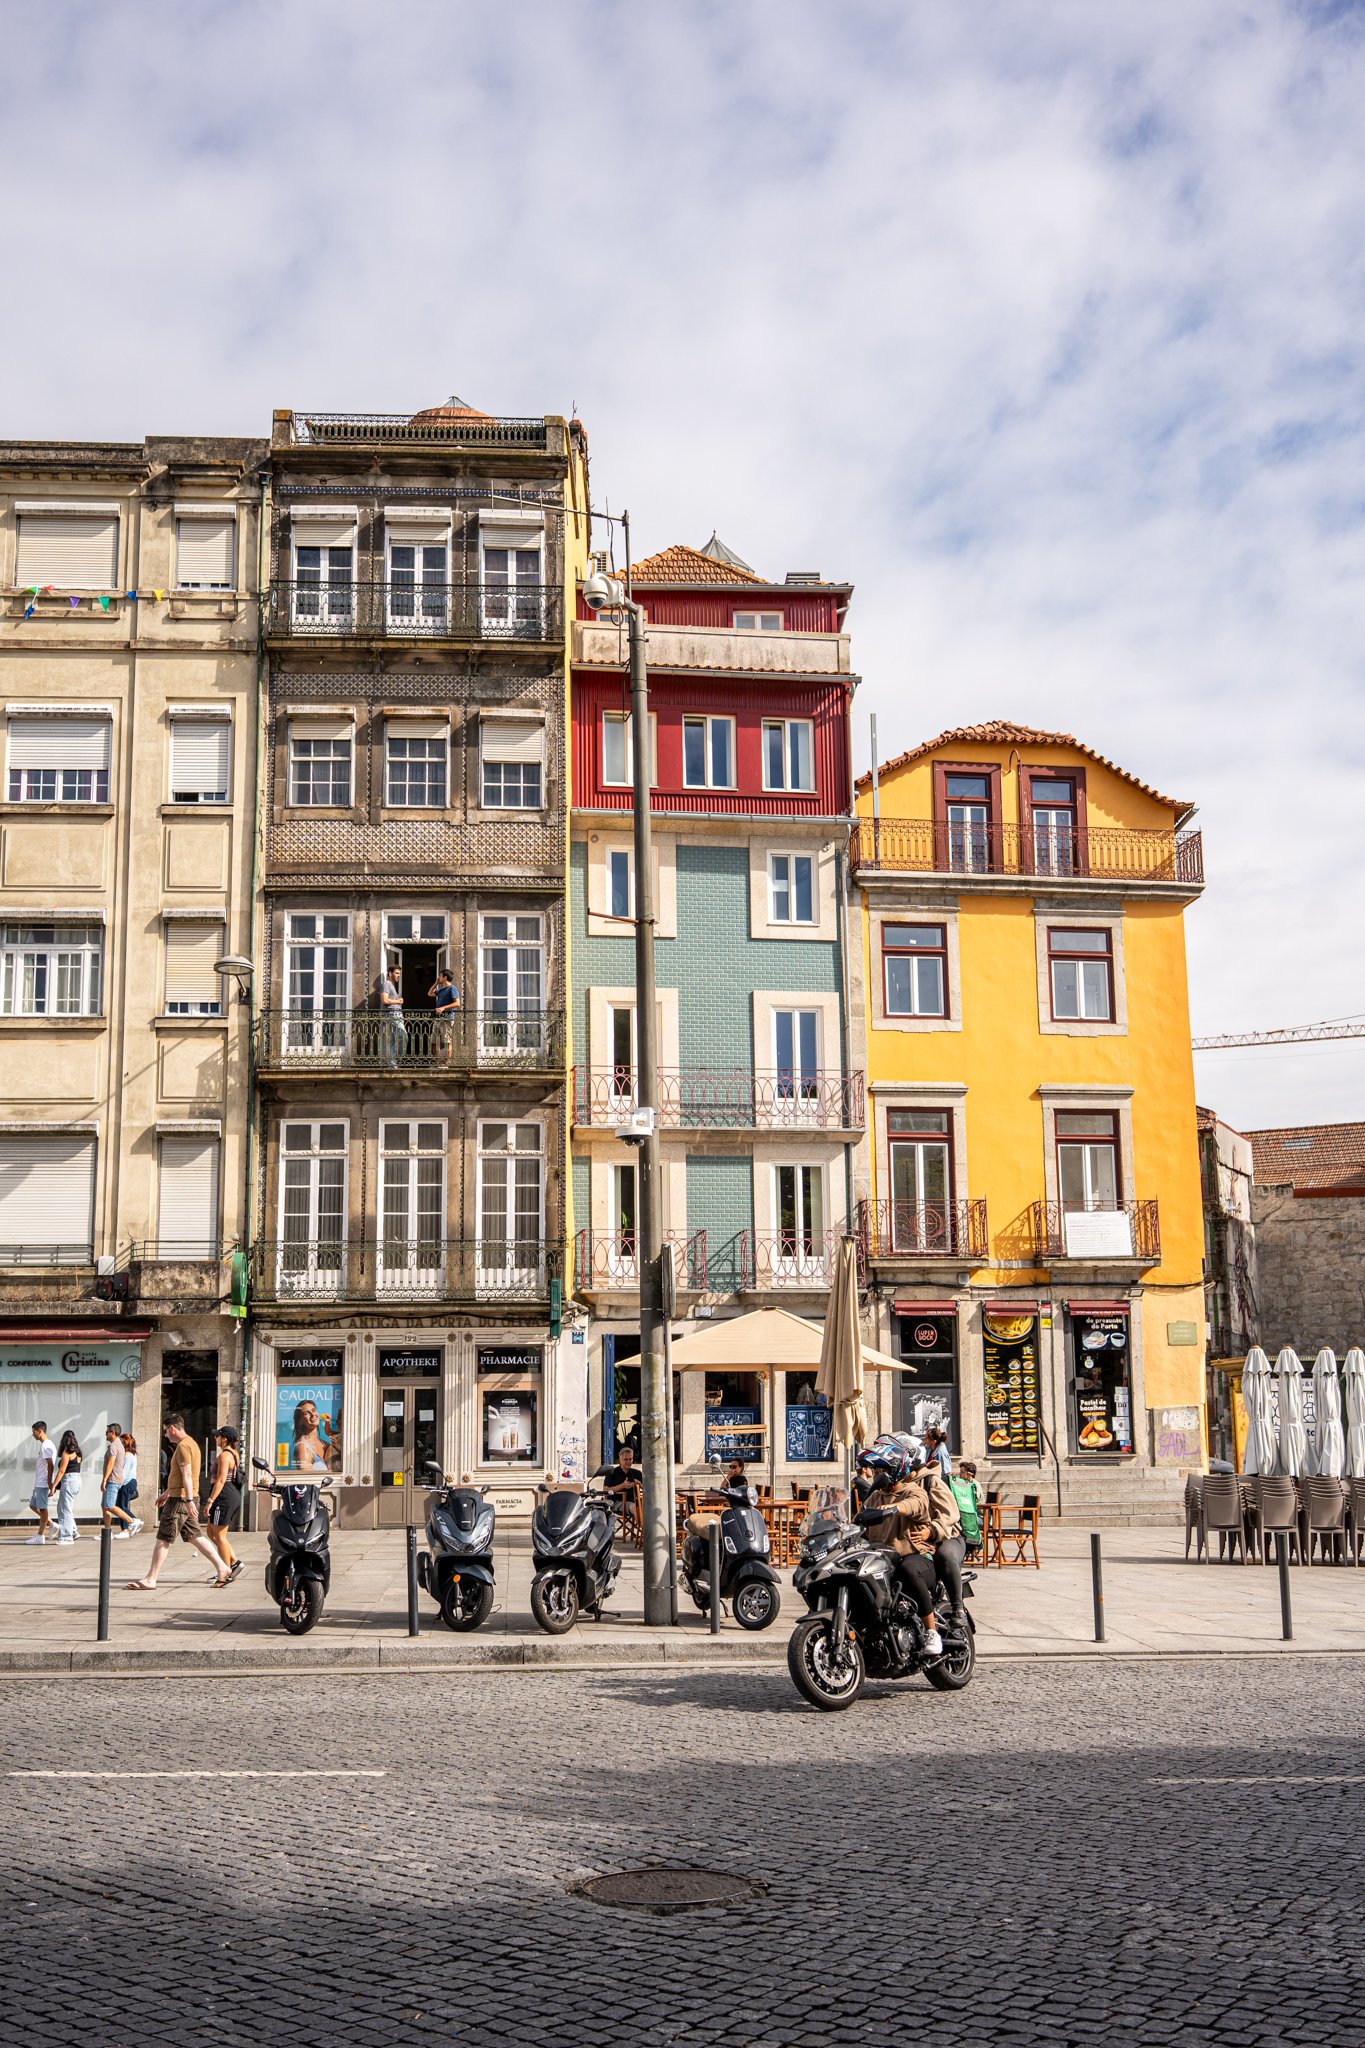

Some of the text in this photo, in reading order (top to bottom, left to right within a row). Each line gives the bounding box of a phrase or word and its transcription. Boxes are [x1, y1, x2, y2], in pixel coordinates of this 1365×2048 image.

[348, 1316, 401, 1328] ANTIGA
[406, 1316, 424, 1328] DA
[431, 1316, 472, 1328] PORTA
[479, 1316, 496, 1328] DO
[61, 1351, 110, 1373] Christina
[281, 1358, 340, 1368] PHARMACY
[382, 1358, 438, 1367] APOTHEKE
[479, 1355, 541, 1365] PHARMACIE
